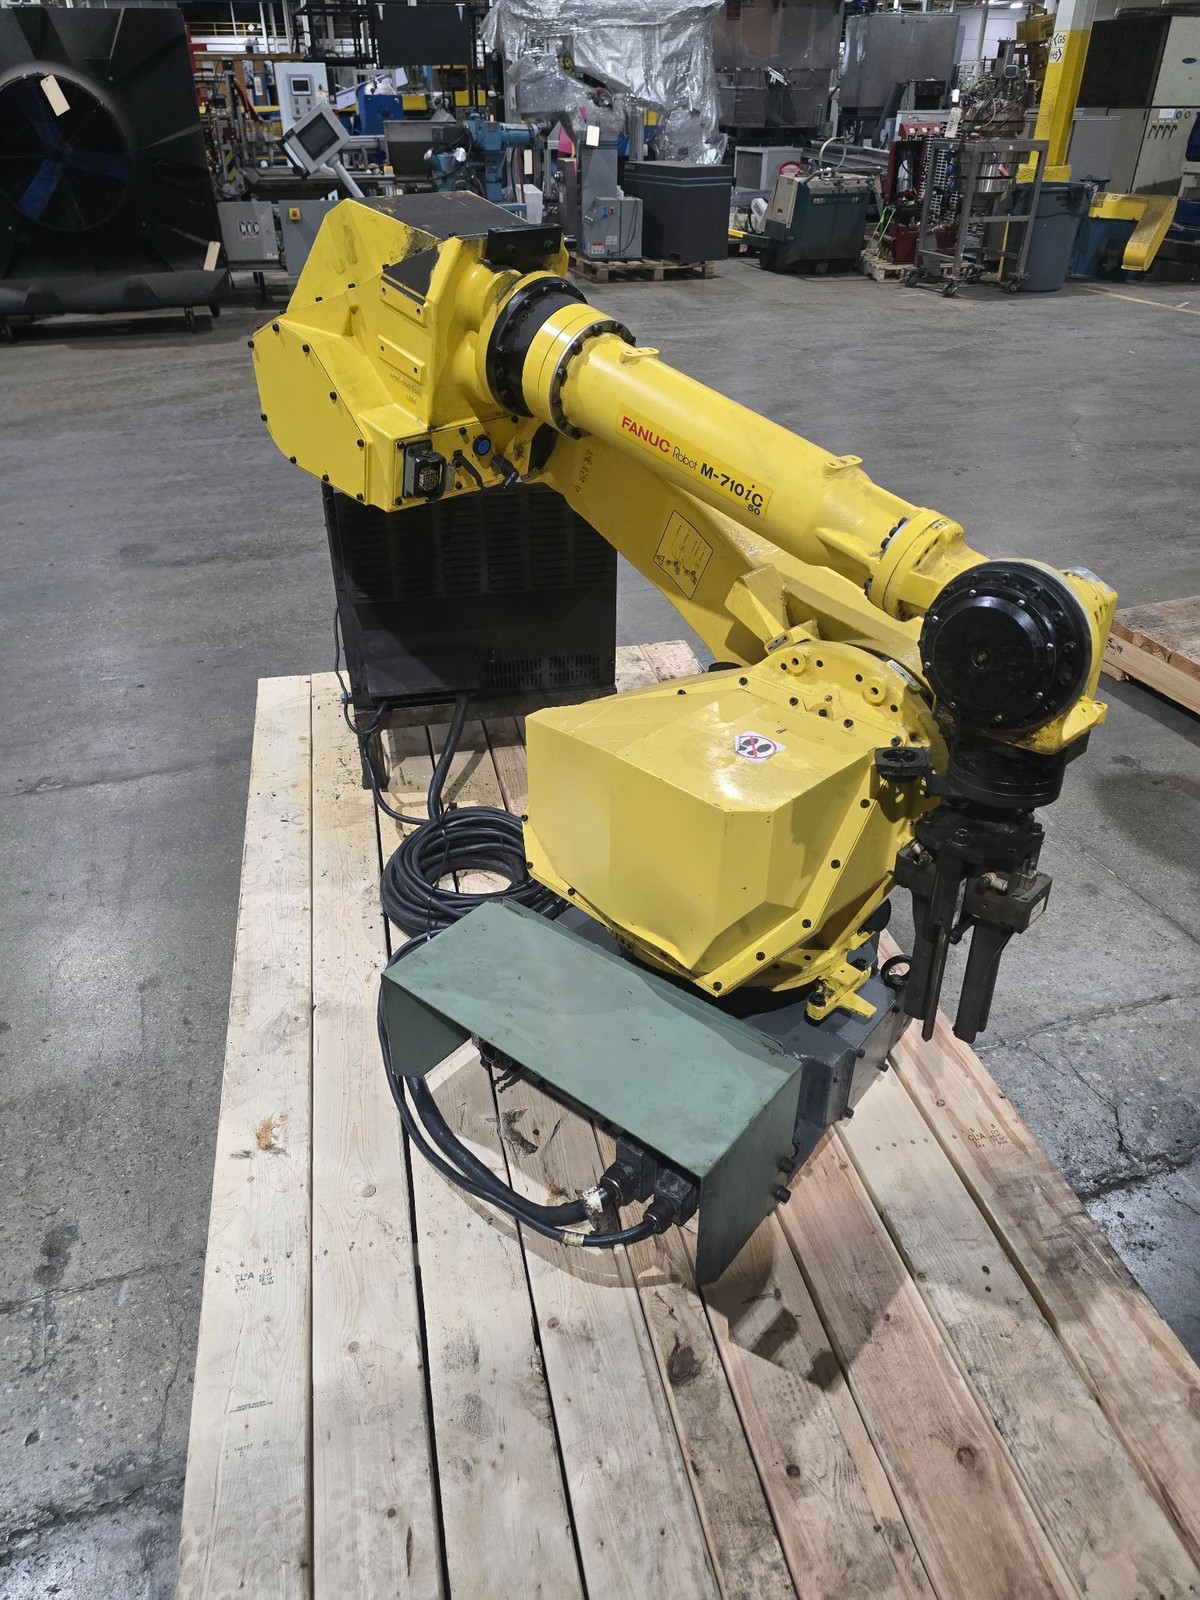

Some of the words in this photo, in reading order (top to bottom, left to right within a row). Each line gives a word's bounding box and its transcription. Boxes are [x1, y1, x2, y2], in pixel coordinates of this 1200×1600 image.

[1057, 34, 1066, 44] G5
[621, 416, 670, 453] FANUC
[672, 446, 698, 471] Robot
[700, 462, 764, 508] M-710iC
[747, 504, 761, 516] 50
